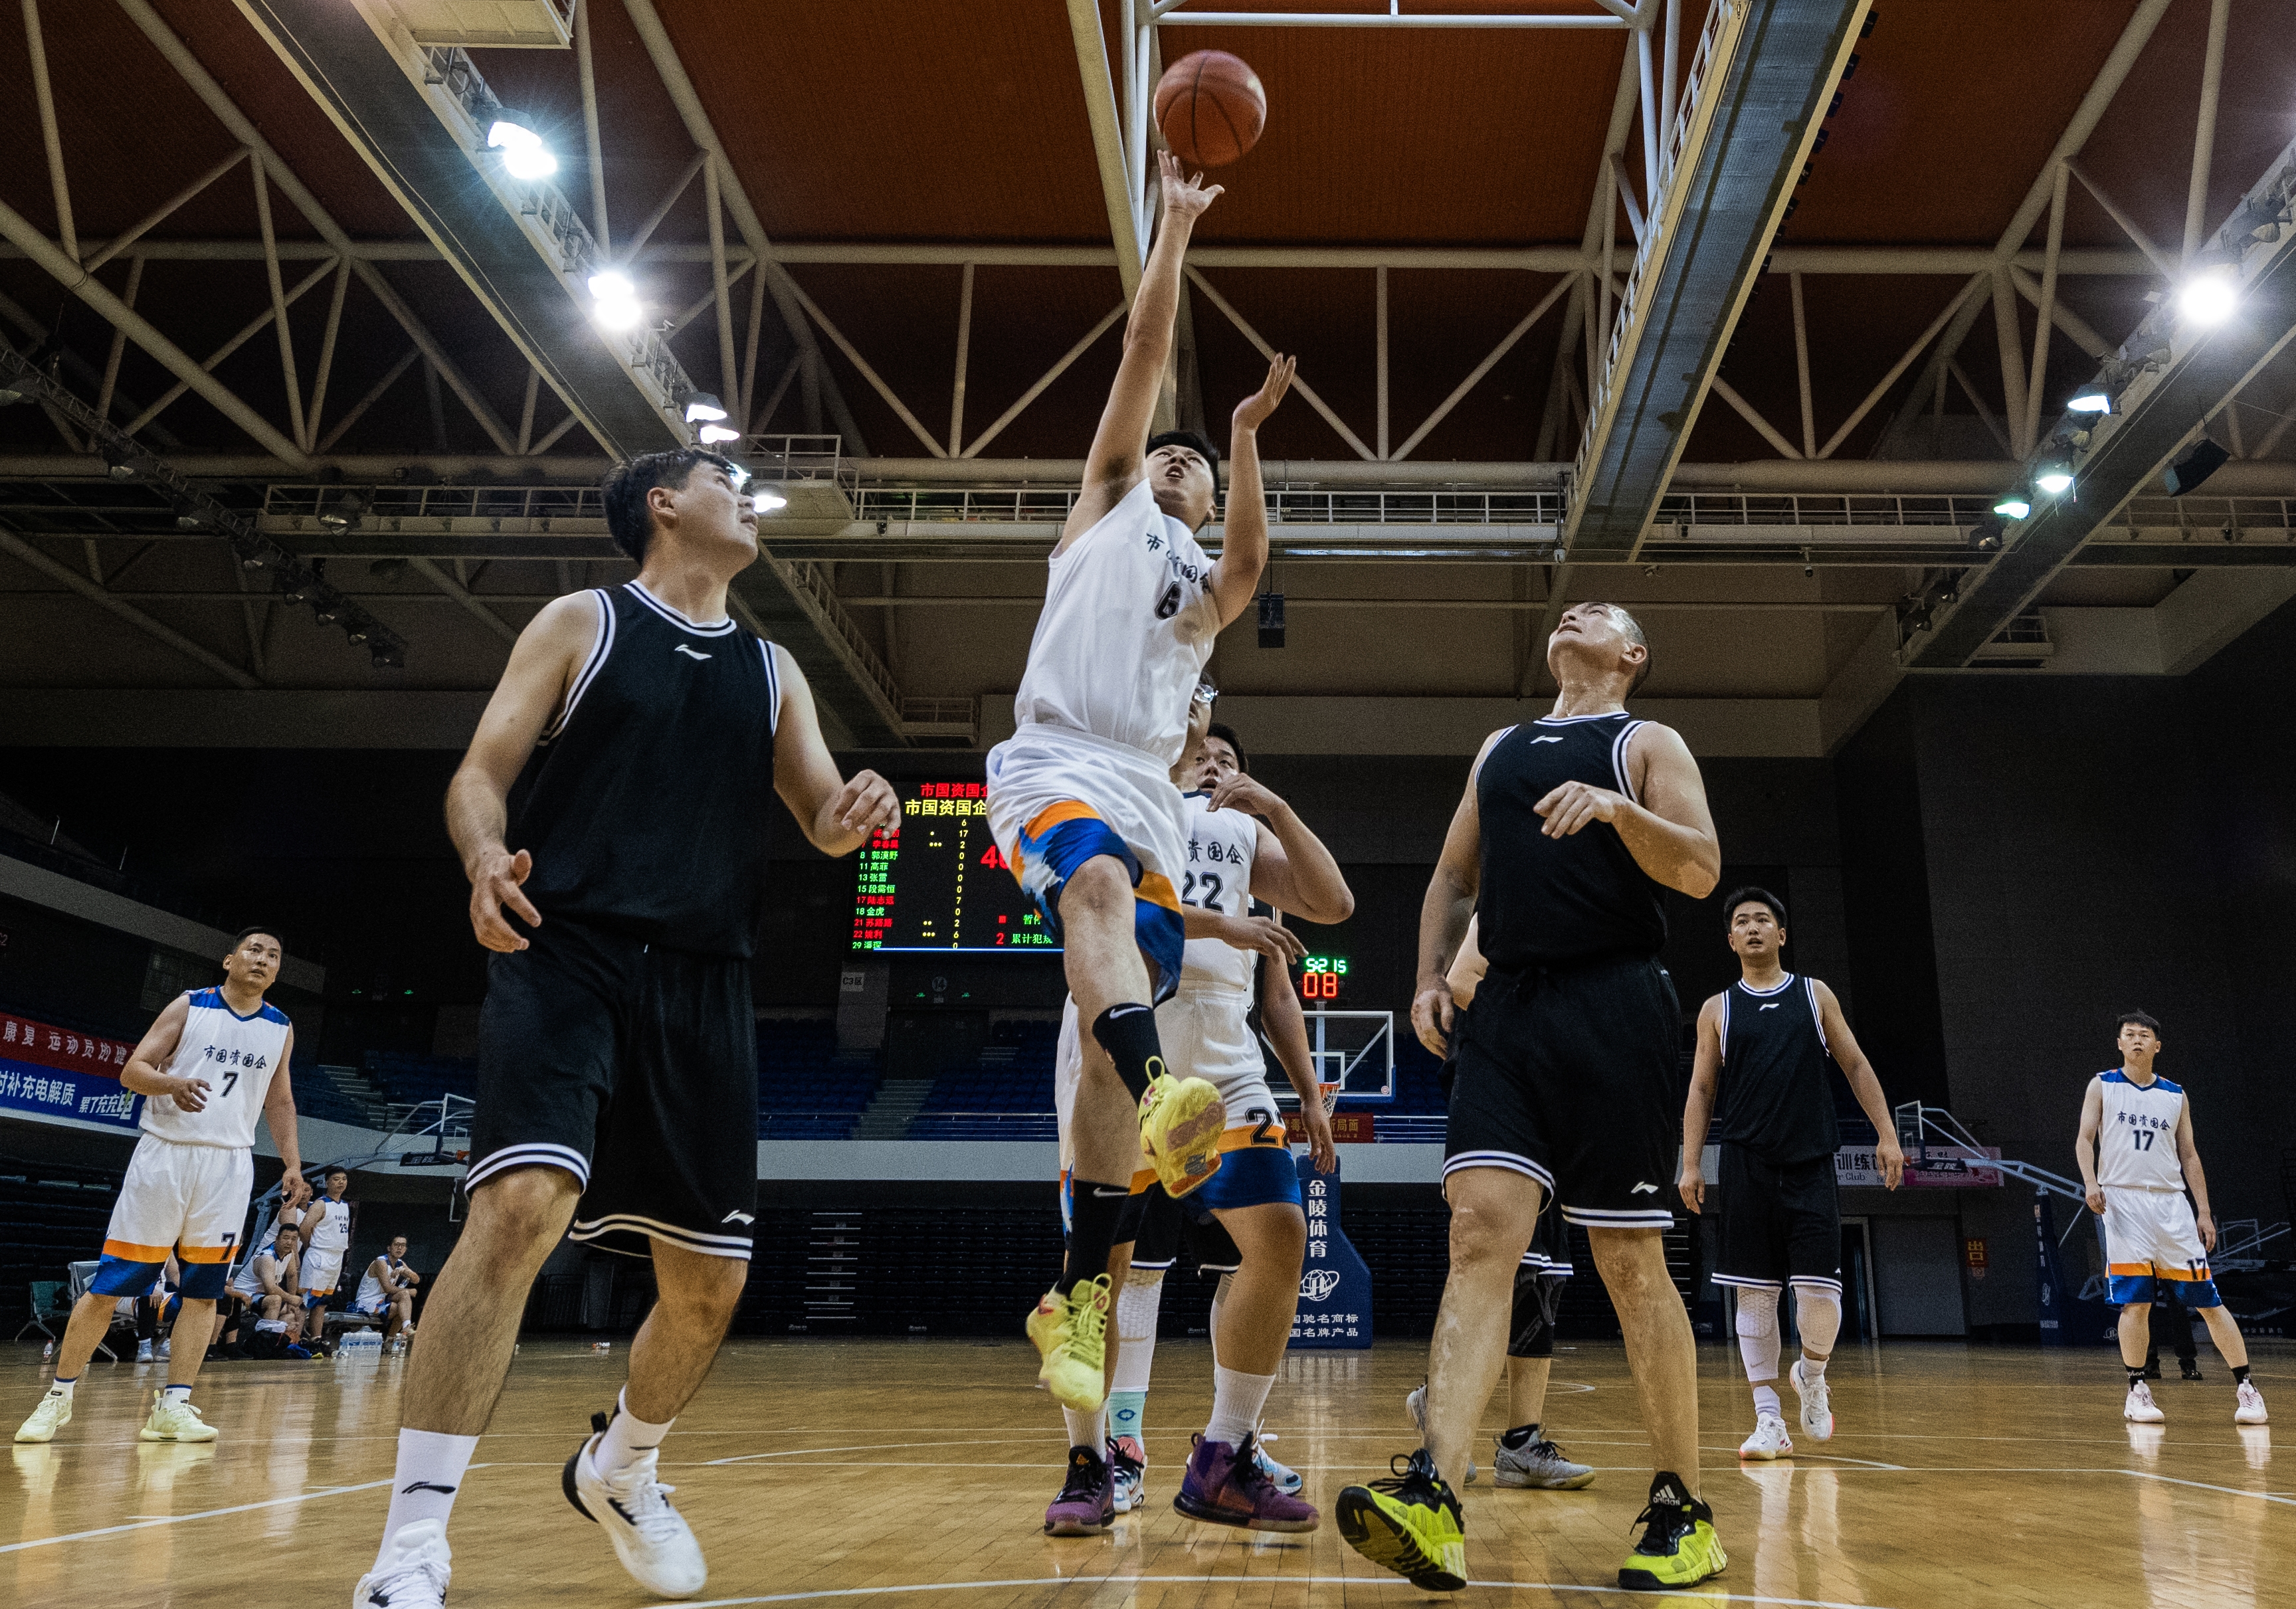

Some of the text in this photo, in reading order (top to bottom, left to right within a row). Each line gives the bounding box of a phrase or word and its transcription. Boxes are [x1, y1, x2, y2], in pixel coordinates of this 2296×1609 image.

[1155, 581, 1181, 620] 6
[905, 799, 987, 816] 市国资国企
[1182, 870, 1224, 913] 22
[866, 907, 885, 916] 金虎
[996, 933, 1005, 944] 2
[1304, 973, 1337, 996] 08
[48, 1030, 136, 1066] 运动员的健
[220, 1071, 239, 1097] 7
[2133, 1129, 2154, 1151] 17
[1846, 1172, 1866, 1181] Club
[1308, 1180, 1328, 1258] 金陵体育
[219, 1232, 237, 1262] 7
[1967, 1240, 1984, 1261] 出口
[2187, 1257, 2206, 1280] 17
[1290, 1327, 1359, 1337] 国名牌产品
